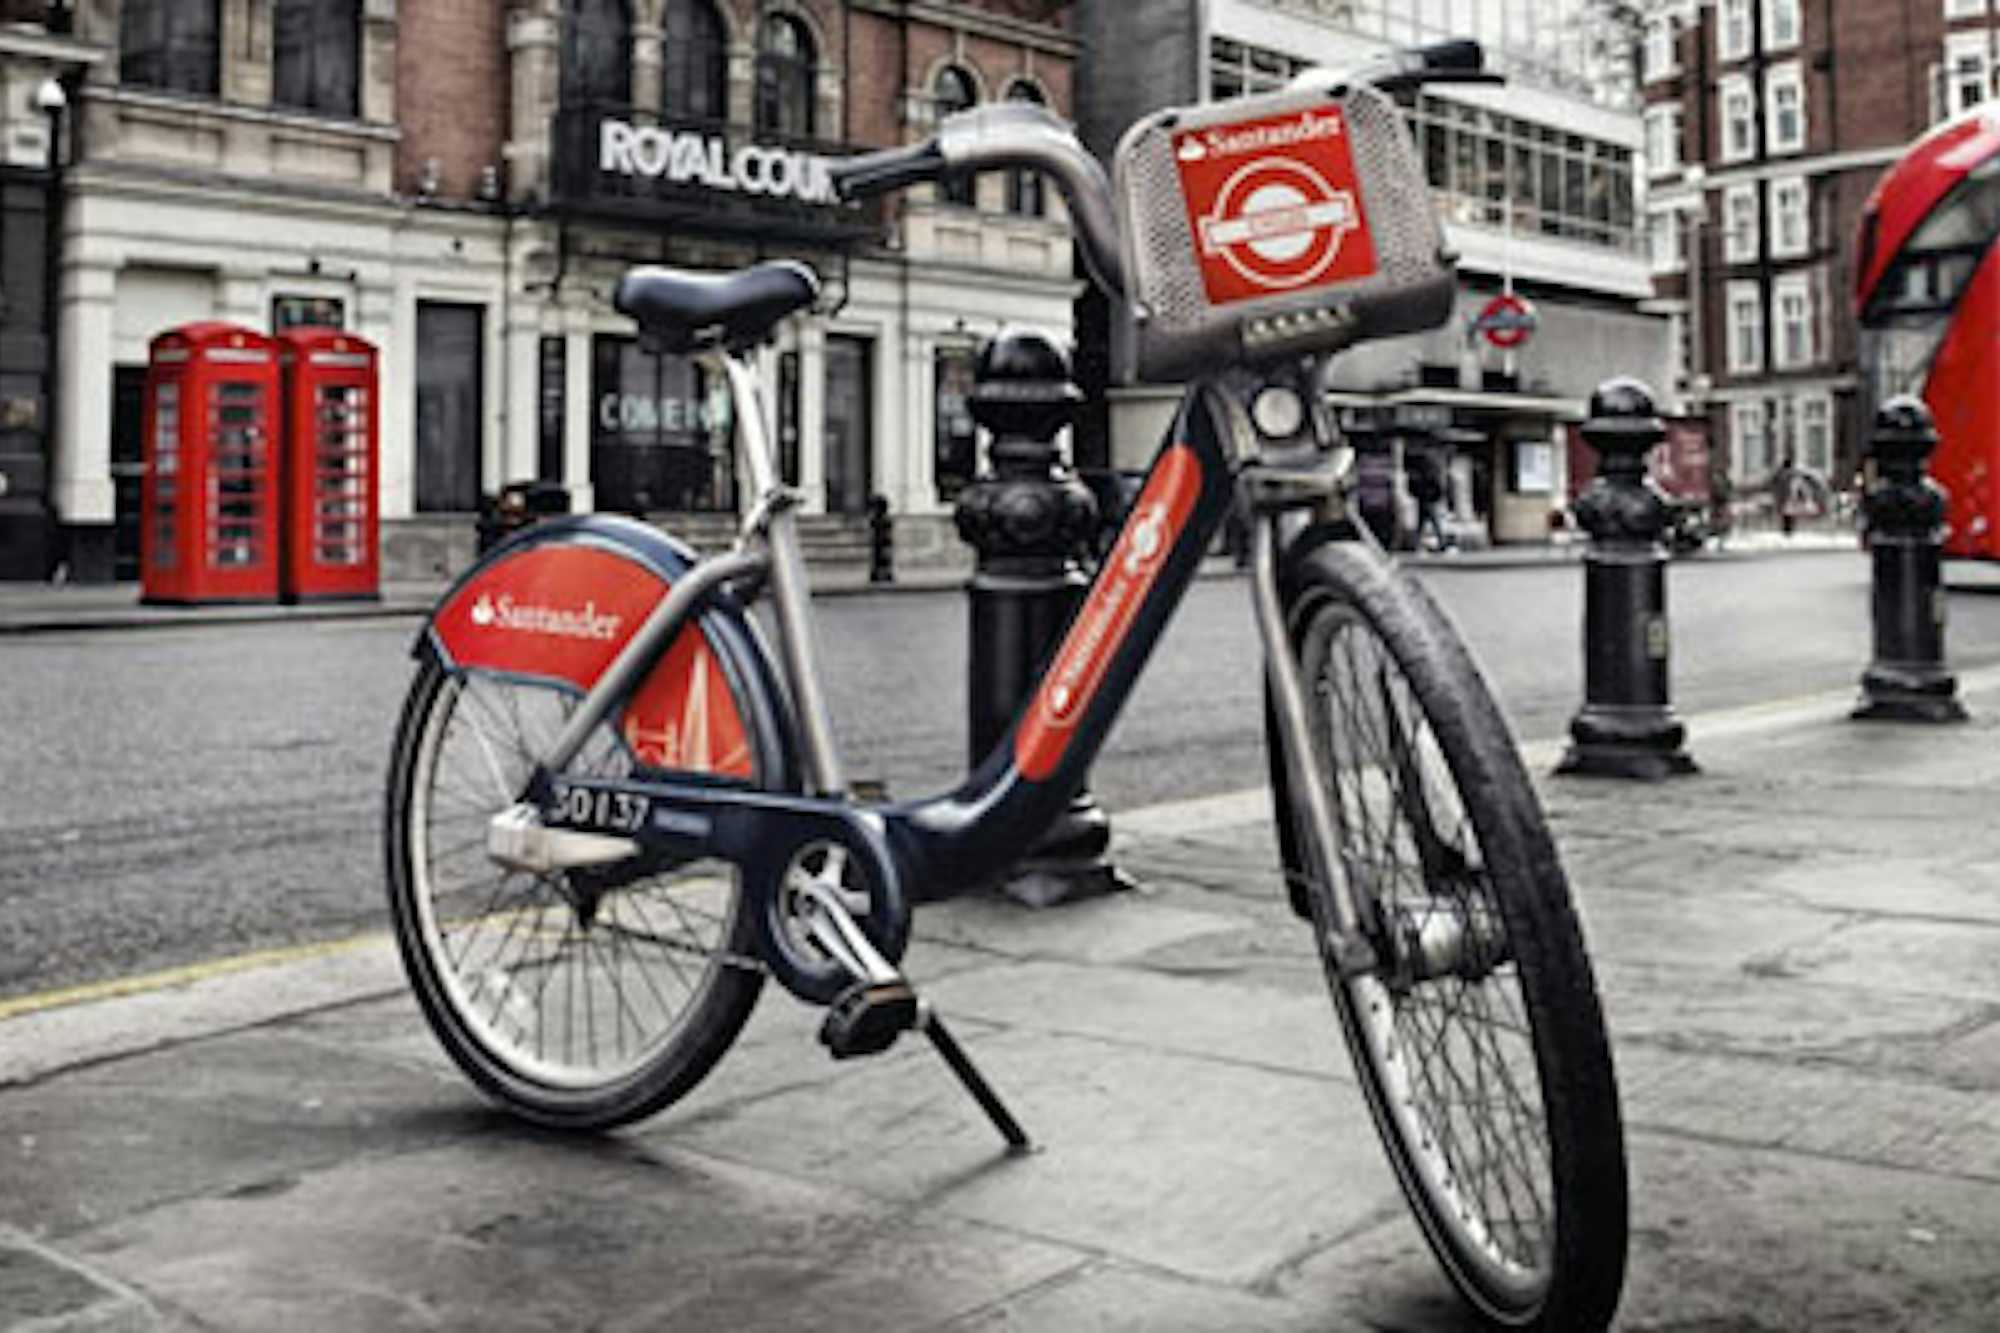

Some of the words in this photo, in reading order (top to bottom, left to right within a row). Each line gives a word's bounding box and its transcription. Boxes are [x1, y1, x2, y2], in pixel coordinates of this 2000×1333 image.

[599, 118, 738, 191] ROYAL
[1206, 111, 1342, 158] Santander
[495, 591, 620, 641] Santander
